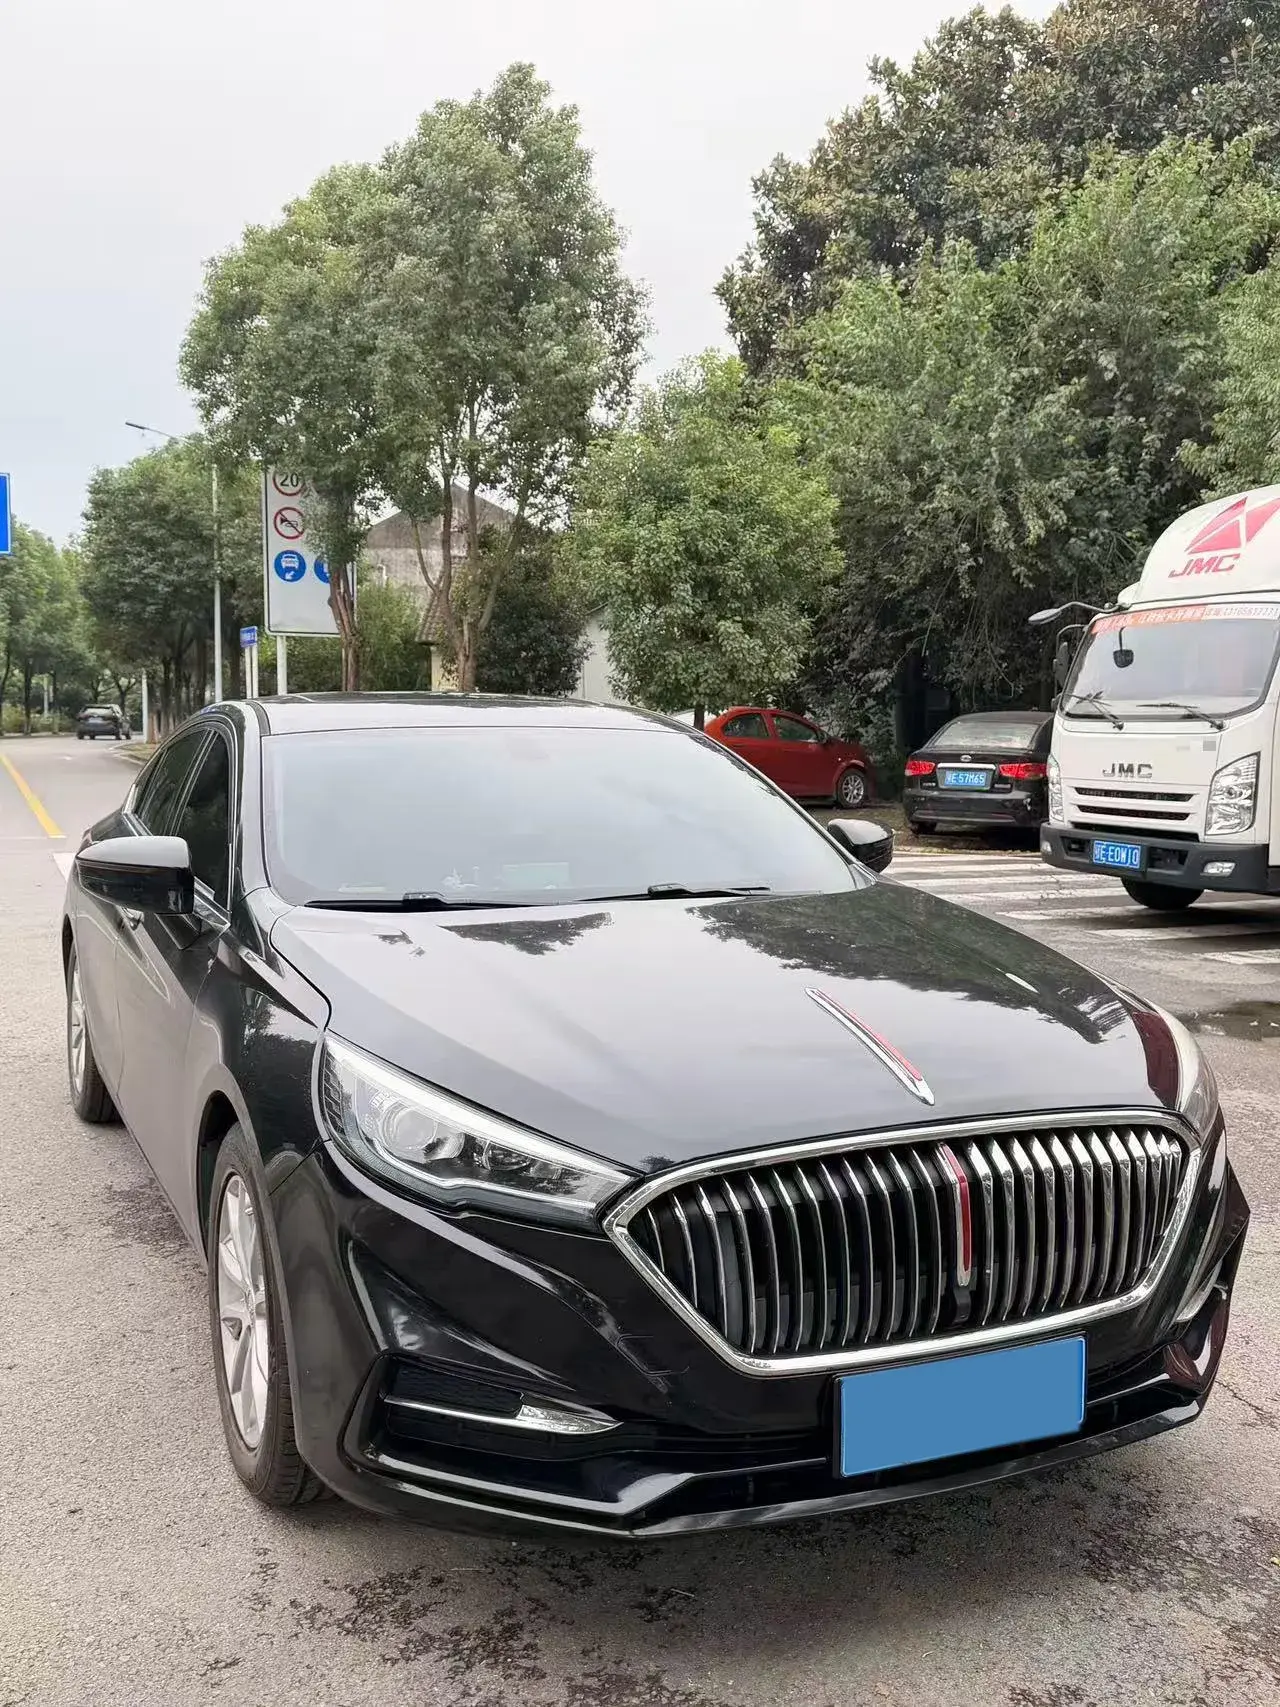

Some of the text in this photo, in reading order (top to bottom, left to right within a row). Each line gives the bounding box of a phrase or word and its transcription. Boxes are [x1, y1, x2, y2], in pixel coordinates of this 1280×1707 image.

[280, 472, 299, 487] 20
[1168, 553, 1240, 578] JMC
[1102, 763, 1152, 778] JMC
